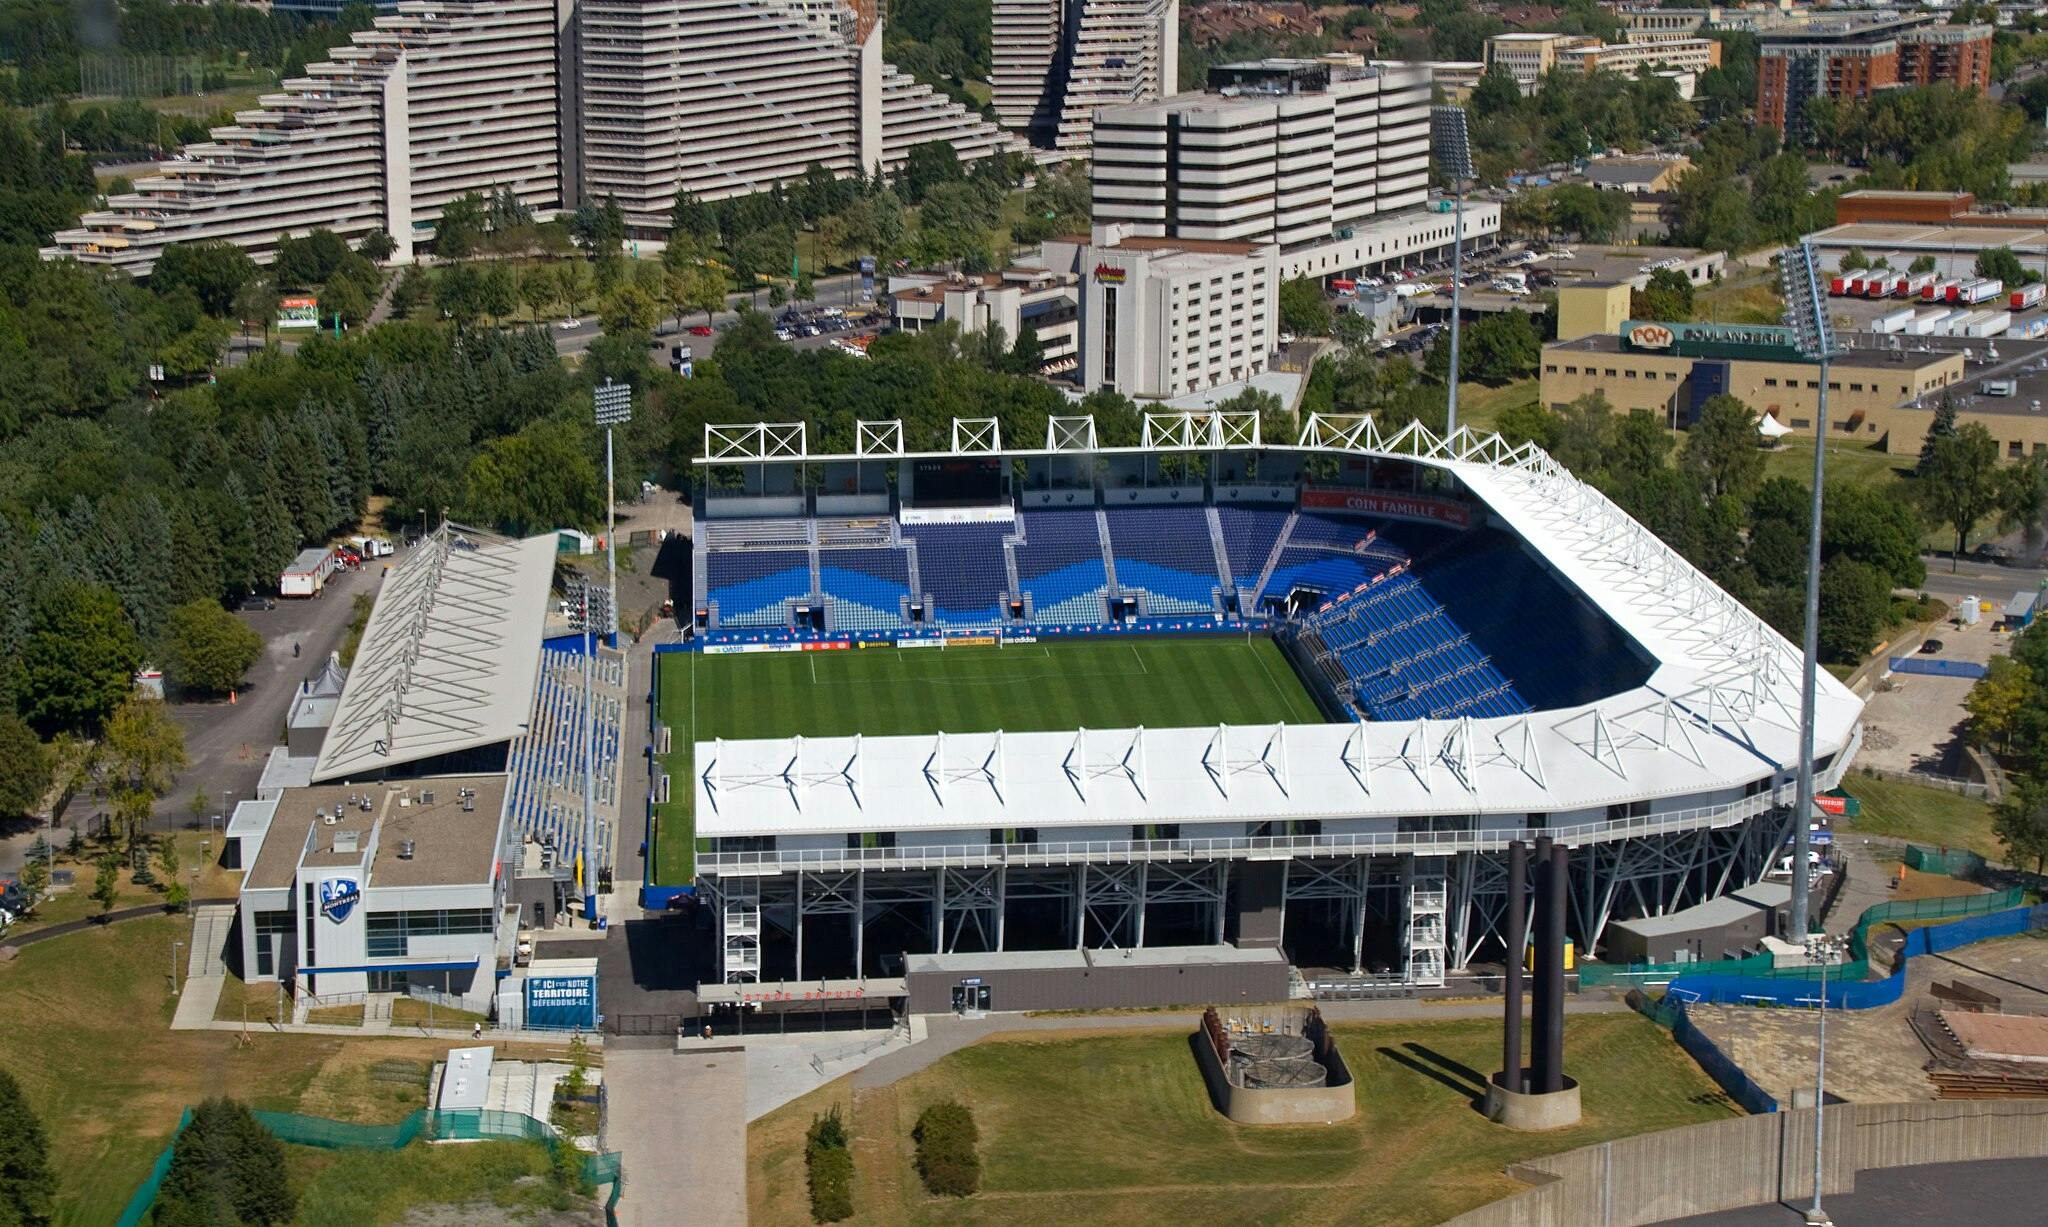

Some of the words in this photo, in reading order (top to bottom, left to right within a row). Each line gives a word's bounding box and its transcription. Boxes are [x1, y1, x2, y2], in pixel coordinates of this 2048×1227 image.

[1632, 327, 1669, 345] POM
[1683, 328, 1785, 344] BOULANGERIE
[1346, 497, 1377, 511] COIN
[1382, 502, 1436, 517] FAMILLE
[543, 980, 555, 988] ICI
[567, 980, 589, 988] NOTRE
[532, 988, 590, 998] TERRITOIRE.
[743, 992, 792, 1002] STADE
[804, 990, 863, 1000] SAPUTO
